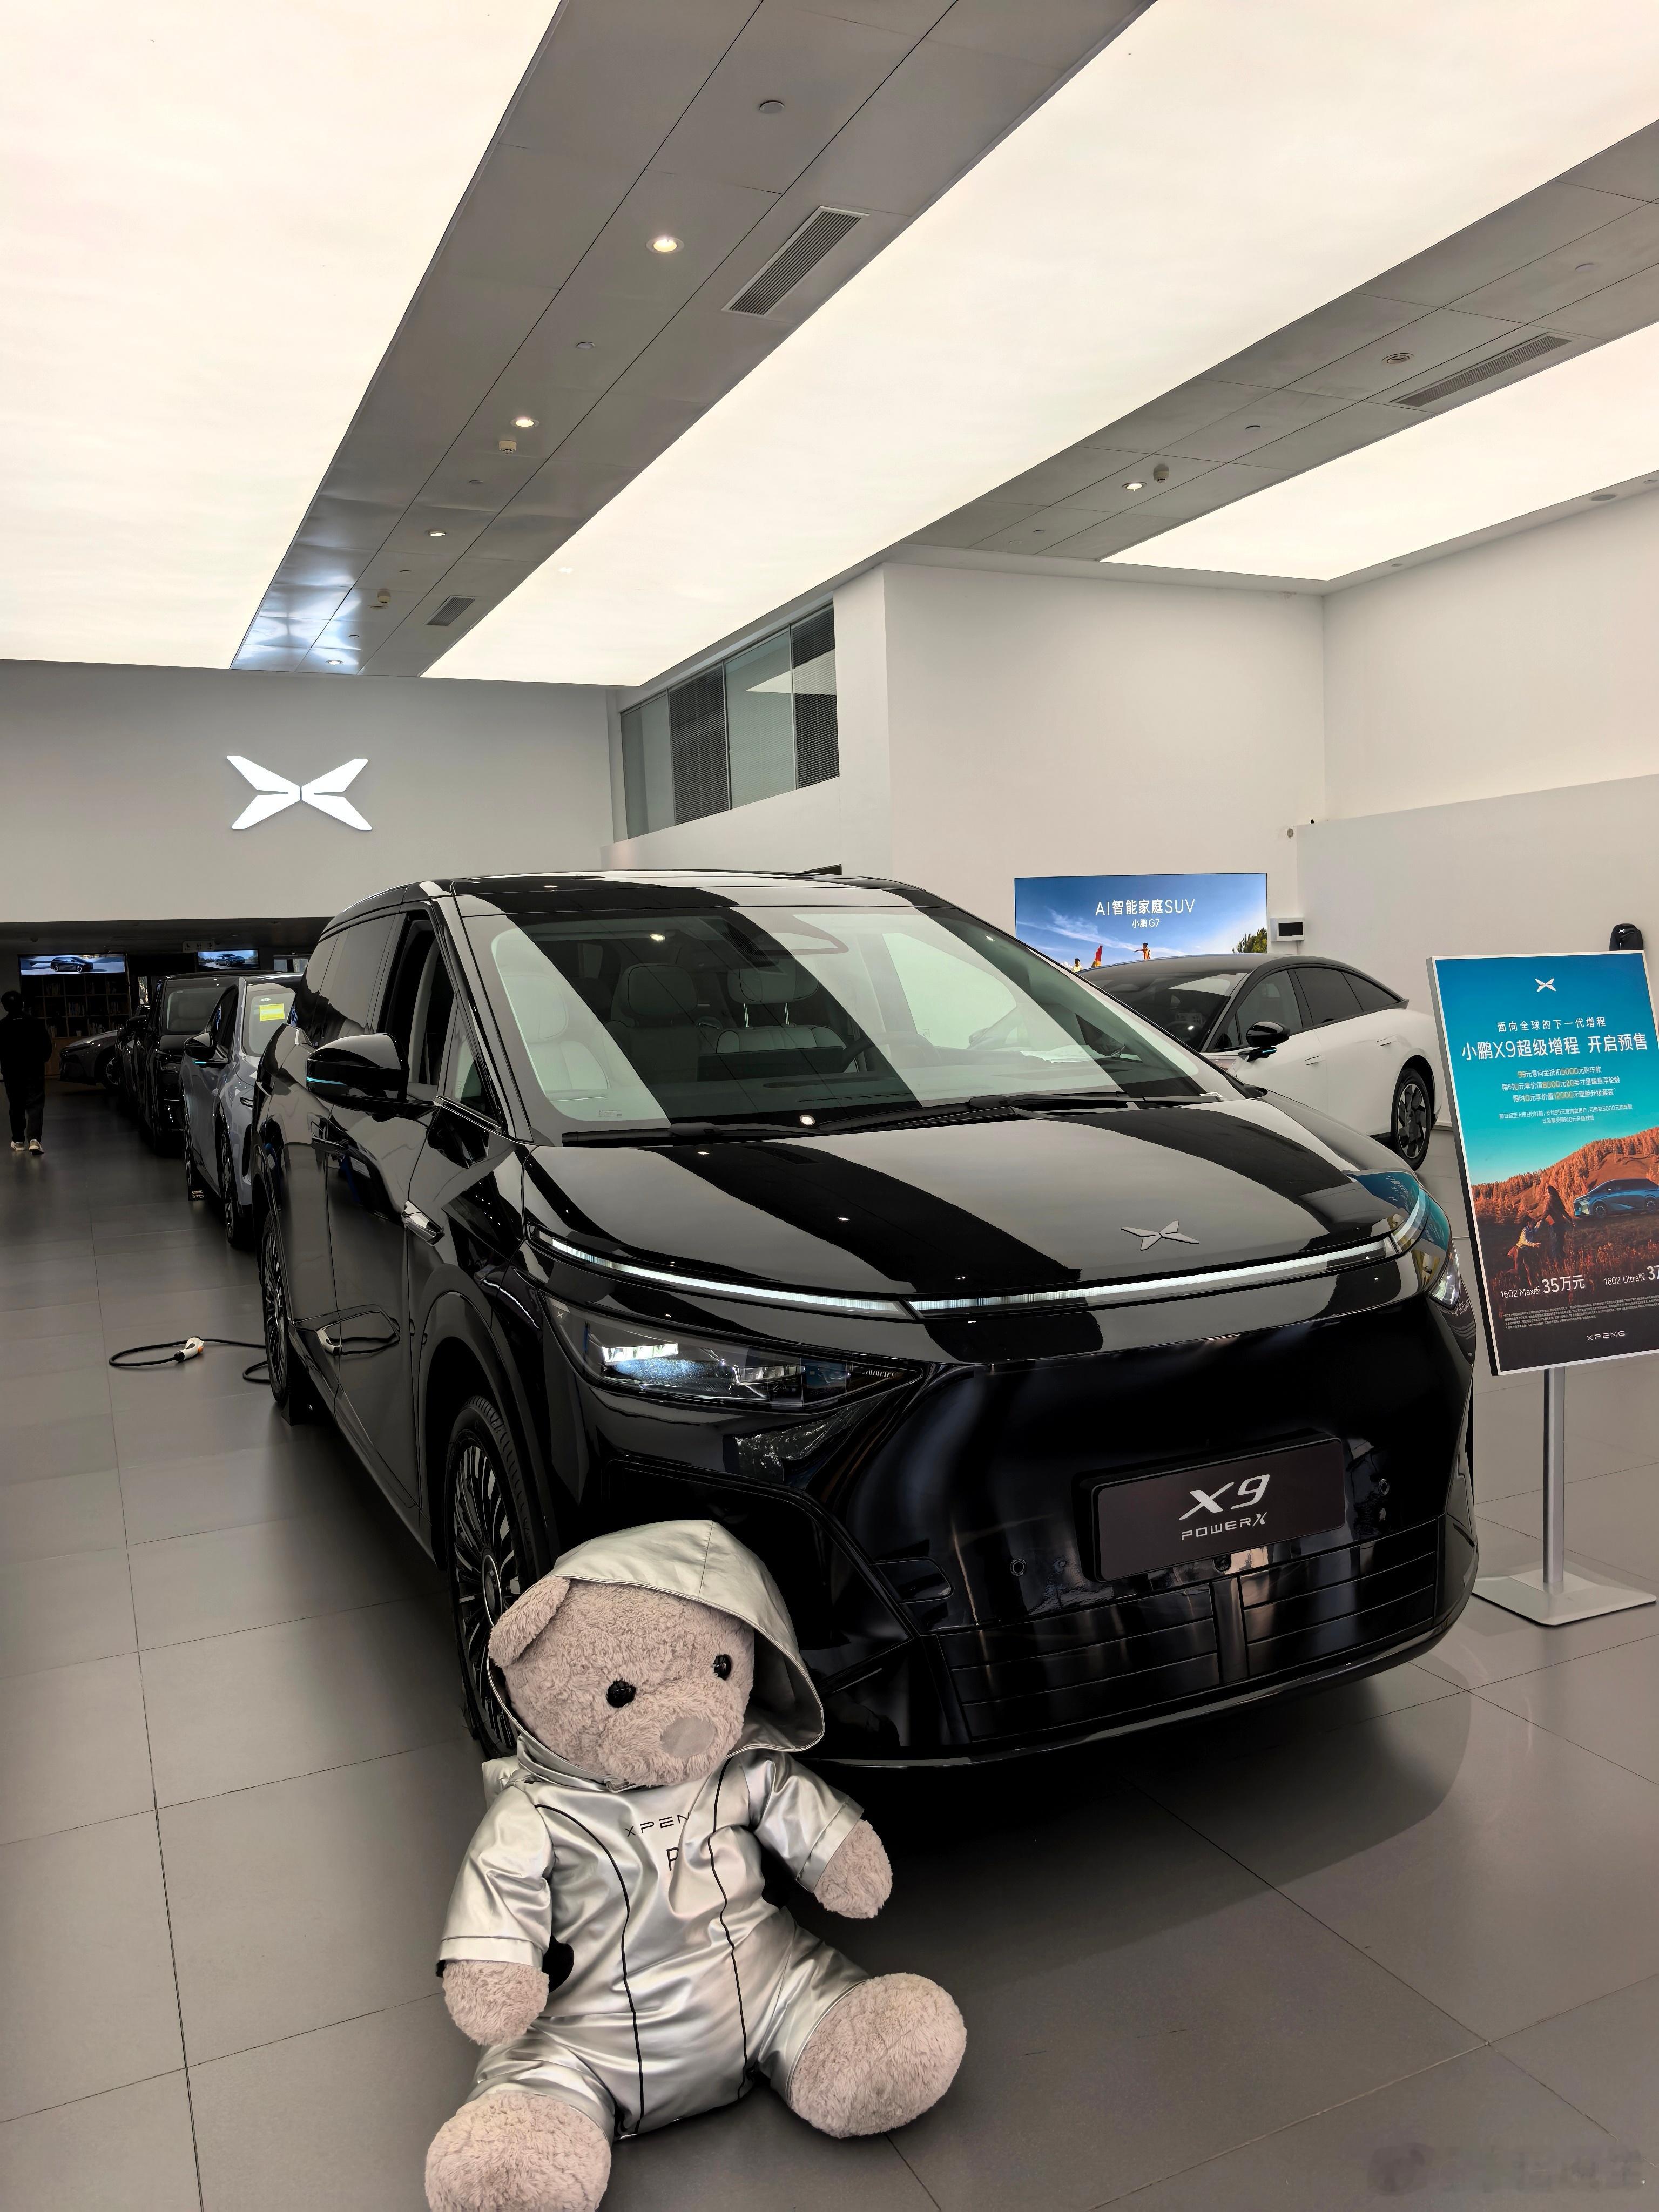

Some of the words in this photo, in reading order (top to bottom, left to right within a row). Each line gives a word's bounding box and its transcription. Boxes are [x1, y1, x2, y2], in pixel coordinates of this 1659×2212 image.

[1095, 899, 1195, 916] AI智能家庭SUV
[1497, 1016, 1607, 1033] 面向全球的下一代增程
[1462, 1036, 1580, 1061] 小鹏X9超级增程
[1587, 1033, 1647, 1053] 开启预售
[1500, 1289, 1518, 1299] 1602
[1519, 1286, 1540, 1297] Max版
[1542, 1274, 1585, 1293] 35万元
[1604, 1276, 1621, 1285] 1602
[1622, 1273, 1645, 1283] Ultra版
[1587, 1330, 1626, 1341] XPENG
[1179, 1474, 1270, 1520] X9
[1181, 1512, 1267, 1541] POWERX
[625, 1811, 691, 1837] XPEN
